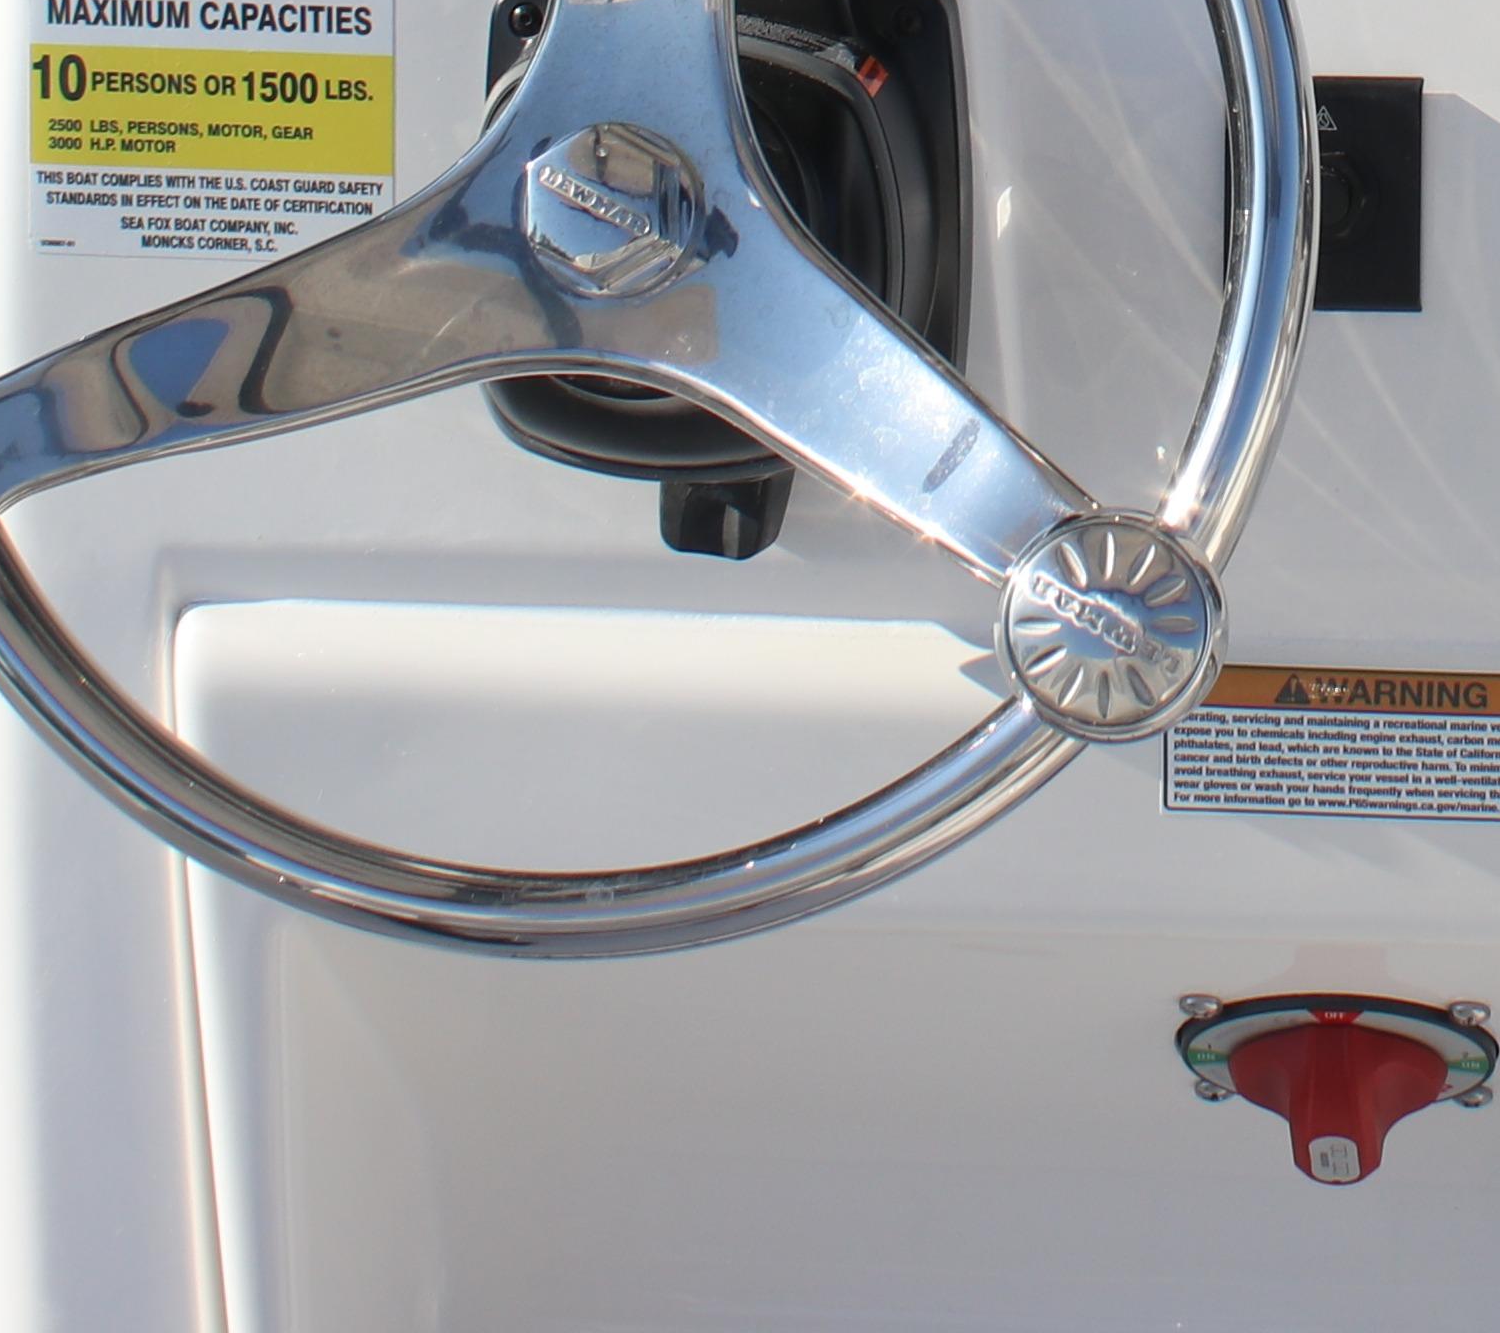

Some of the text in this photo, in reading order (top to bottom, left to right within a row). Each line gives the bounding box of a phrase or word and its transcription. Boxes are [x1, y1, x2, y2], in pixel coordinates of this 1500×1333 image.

[199, 1, 373, 35] CAPACITIES
[33, 54, 374, 104] 10 PERSONS OR 1500 LBS.
[48, 119, 314, 141] 2500 LBS, PERSONS, MOTOR, GEAR
[48, 137, 176, 153] 3000 H.P. MOTOR
[36, 170, 383, 196] THIS BOAT COMPLIES WITH THE U.S. COAST GUARD SAFETY
[46, 192, 374, 216] STANDARDS IN EFFECT ON THE DATE OF CERTIFICATION
[121, 216, 299, 236] SEA FOX BOAT COMPANY, INC.
[141, 236, 279, 254] MONCKS CORNER, S.C.
[1309, 677, 1488, 709] WARNING
[1174, 727, 1212, 740] expose
[1214, 728, 1234, 740] you
[1236, 726, 1248, 738] to
[1250, 727, 1305, 740] chemicals
[1307, 729, 1357, 744] including
[1359, 730, 1396, 745] engine
[1398, 731, 1443, 746] exhaust,
[1446, 733, 1484, 745] carbon
[1173, 791, 1500, 815] For more information go to www.P65warnings.ca.gov/marine.
[1324, 1010, 1346, 1020] OFF
